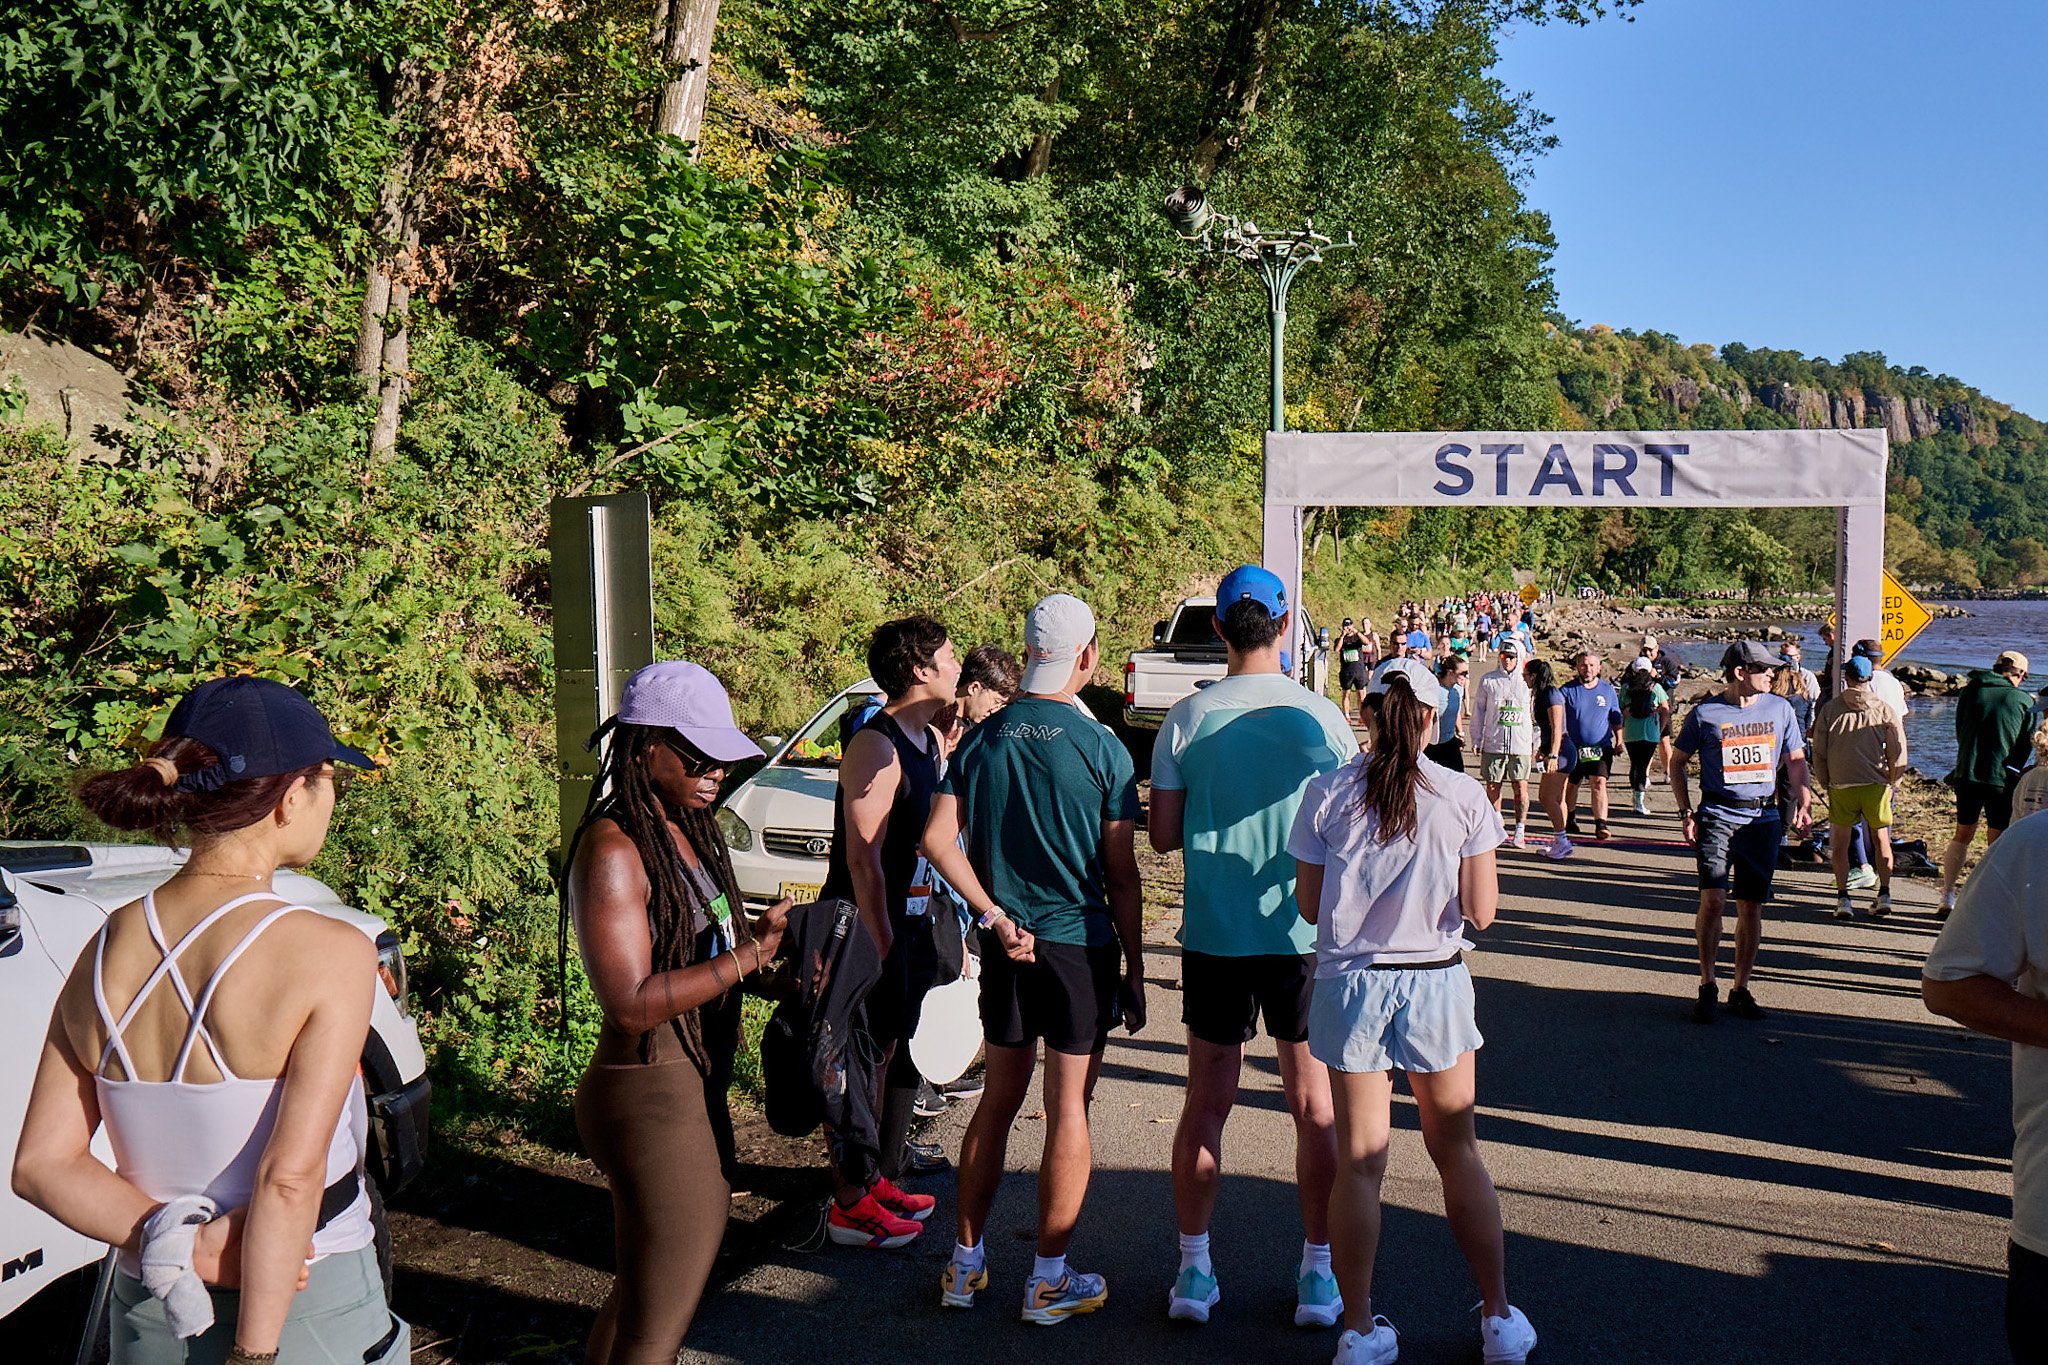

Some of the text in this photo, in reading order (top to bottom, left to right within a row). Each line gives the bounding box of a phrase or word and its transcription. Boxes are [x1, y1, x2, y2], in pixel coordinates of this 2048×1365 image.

[1433, 443, 1690, 496] START
[1882, 596, 1903, 609] ED
[1882, 612, 1904, 625] PS
[1881, 628, 1904, 641] AD
[1499, 711, 1521, 722] 2237
[1731, 746, 1762, 765] 305
